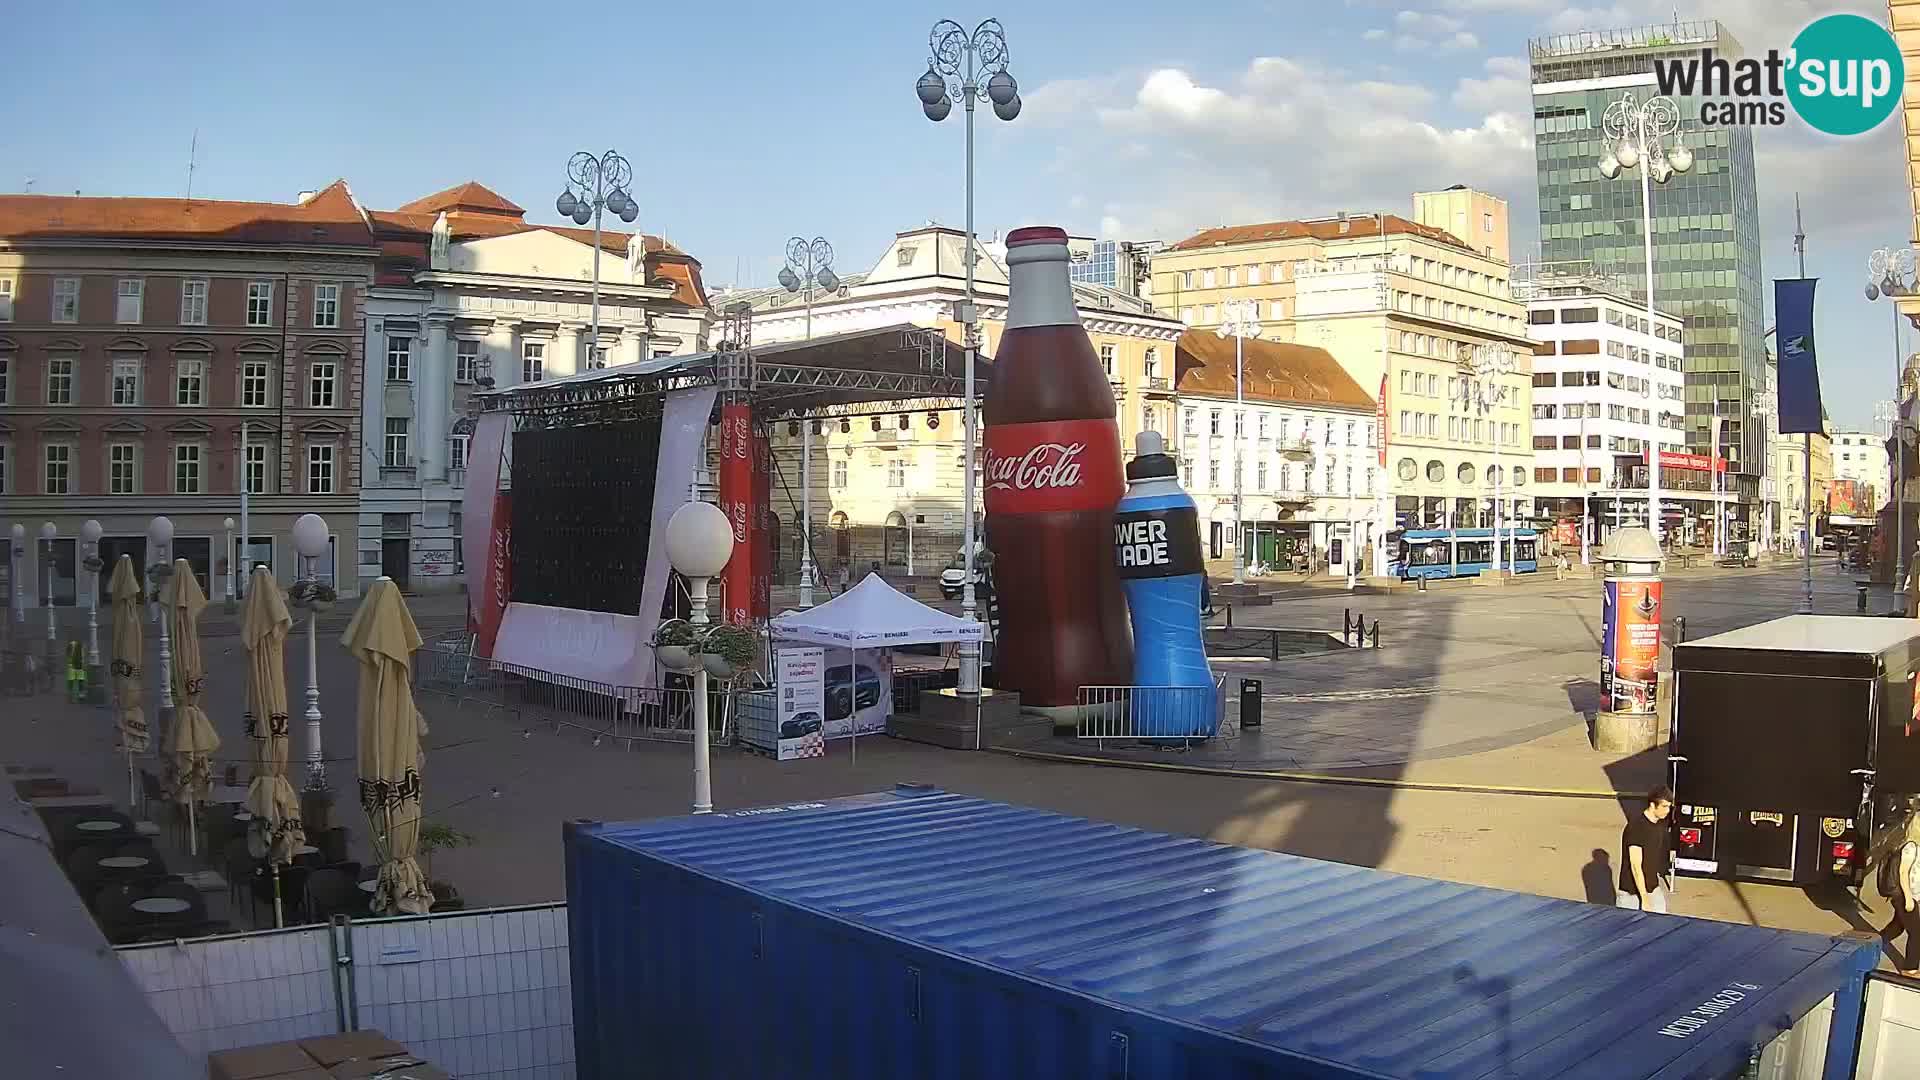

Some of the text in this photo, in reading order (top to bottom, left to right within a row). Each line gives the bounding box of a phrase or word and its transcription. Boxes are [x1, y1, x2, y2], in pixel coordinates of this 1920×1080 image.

[734, 416, 747, 459] Coca-Cola
[734, 501, 746, 543] Coca-Cola
[1114, 520, 1168, 545] WER
[1691, 989, 1746, 1018] 300629
